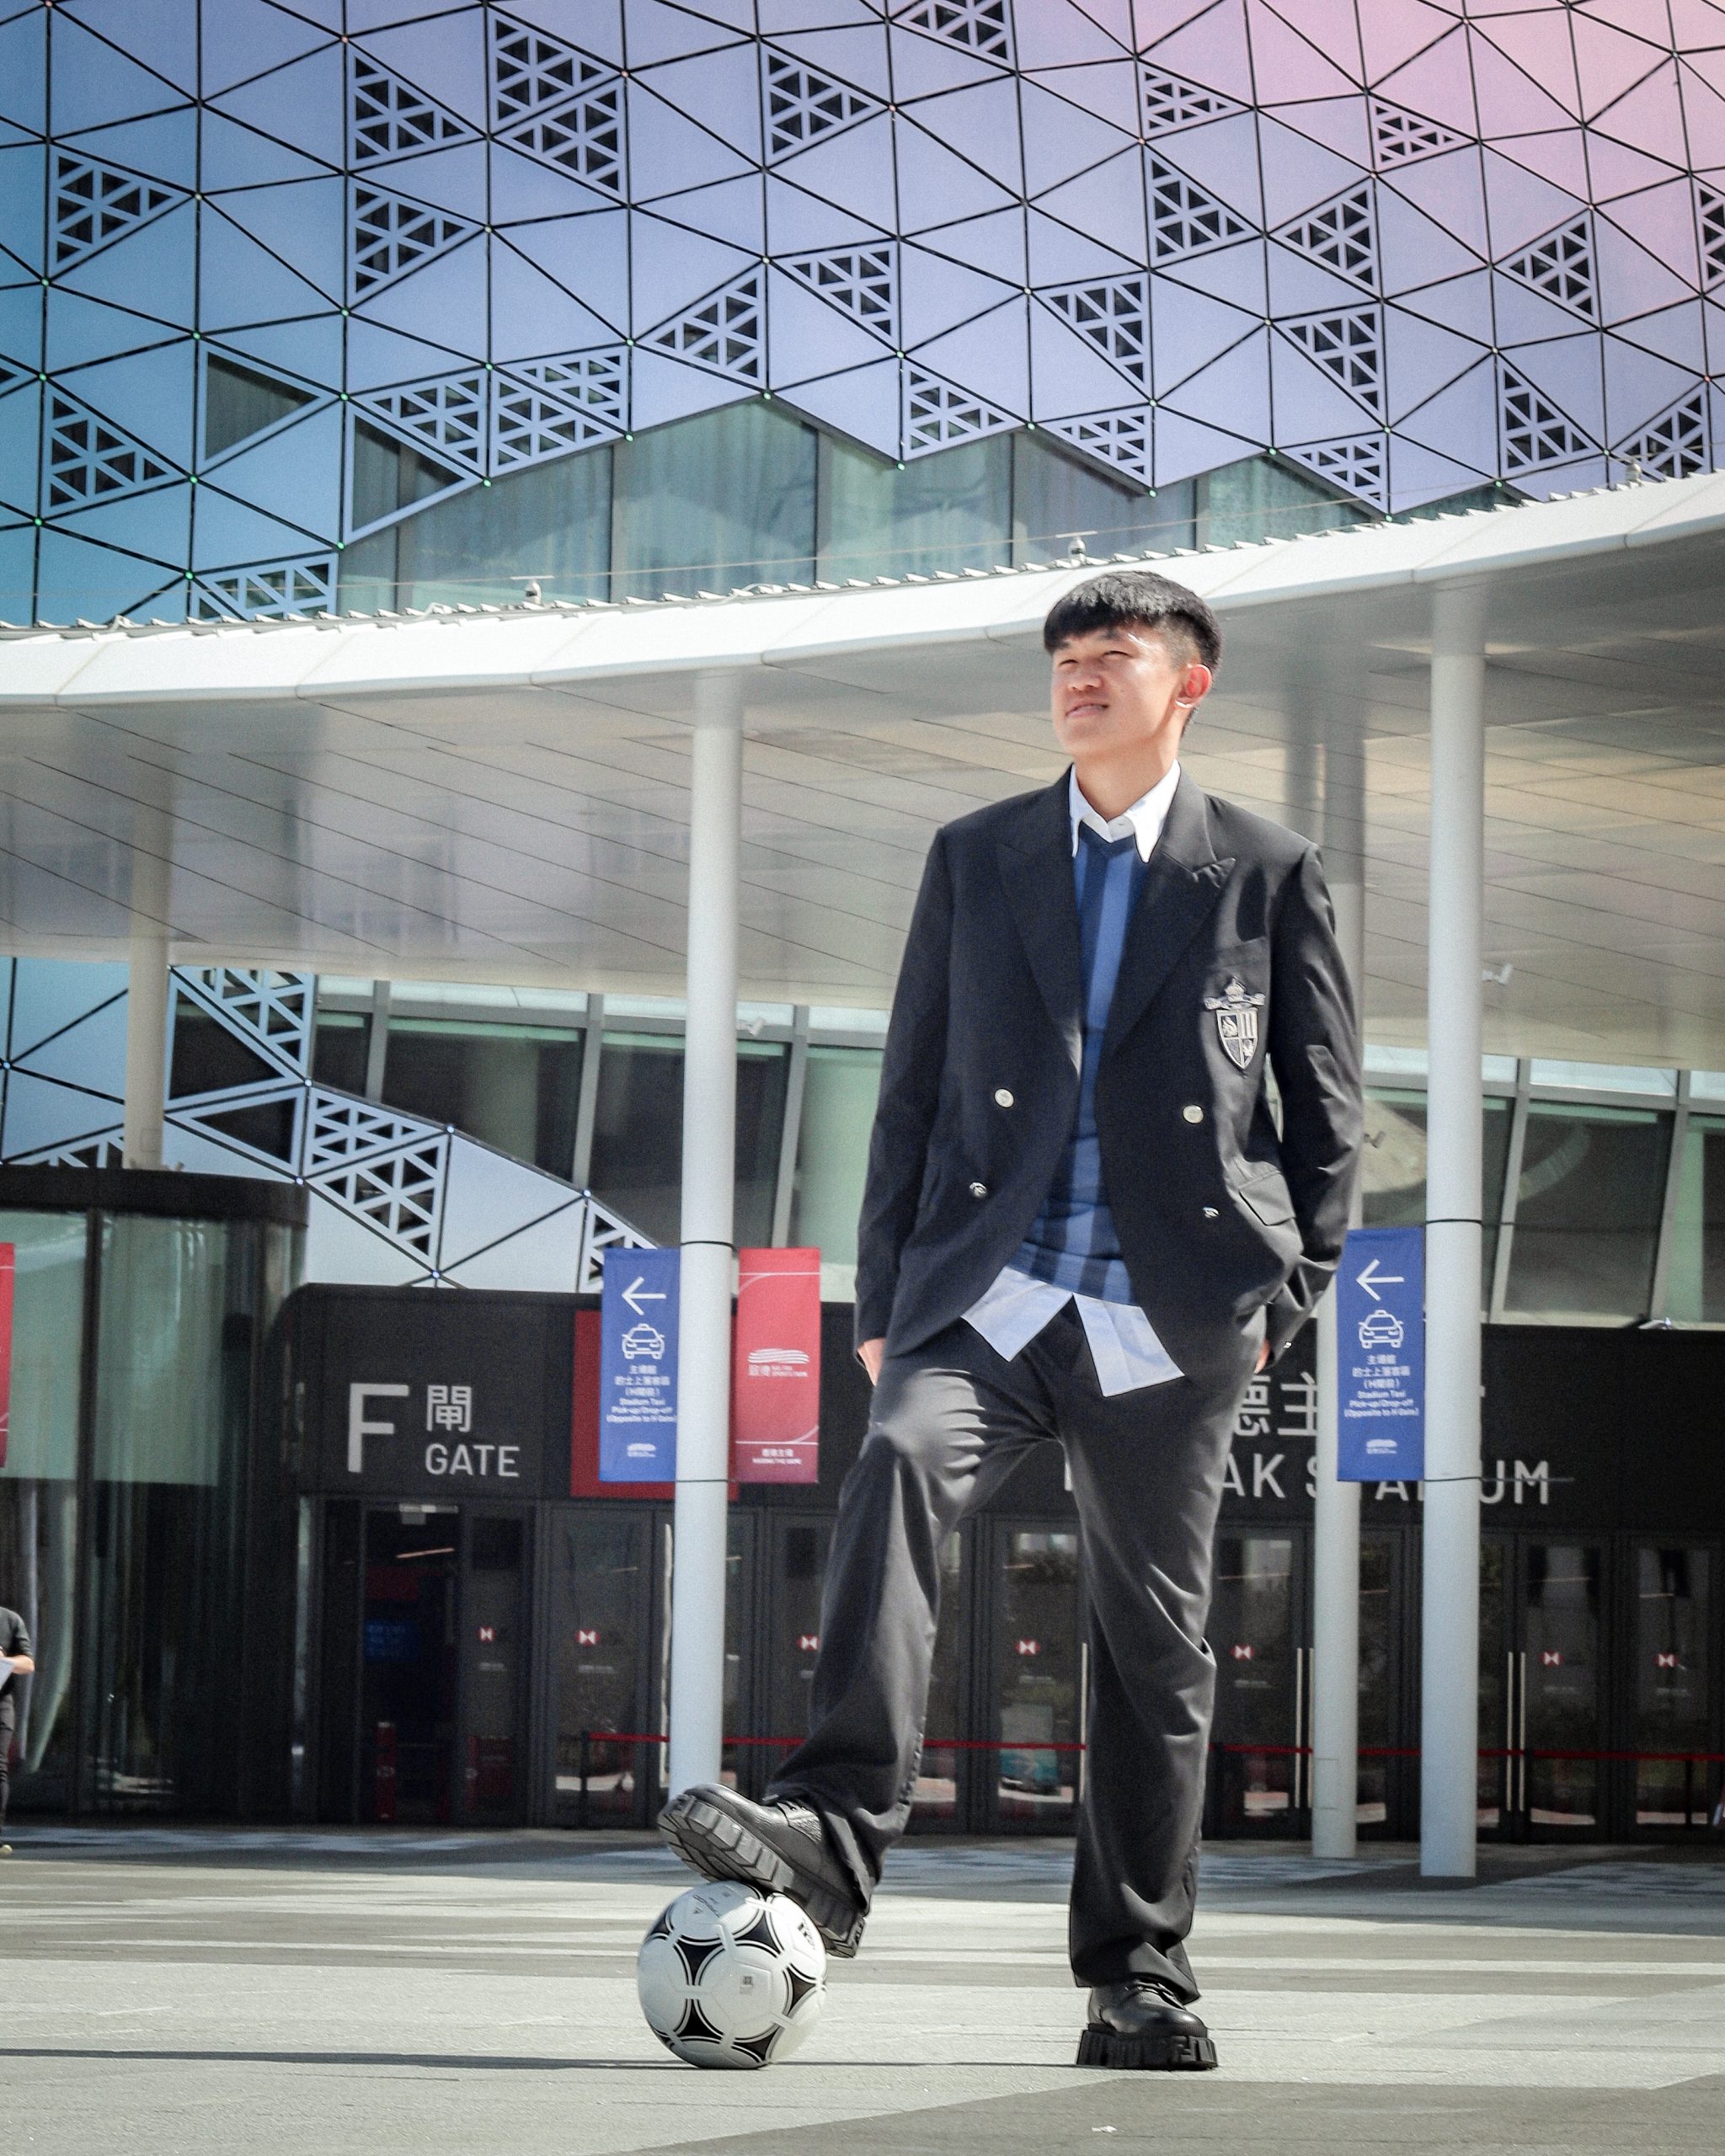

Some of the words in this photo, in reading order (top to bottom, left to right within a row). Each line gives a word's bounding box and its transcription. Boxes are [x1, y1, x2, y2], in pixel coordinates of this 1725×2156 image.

[348, 1382, 409, 1473] F
[426, 1385, 472, 1432] 閘
[425, 1444, 521, 1477] GATE
[1223, 1453, 1286, 1498] AK
